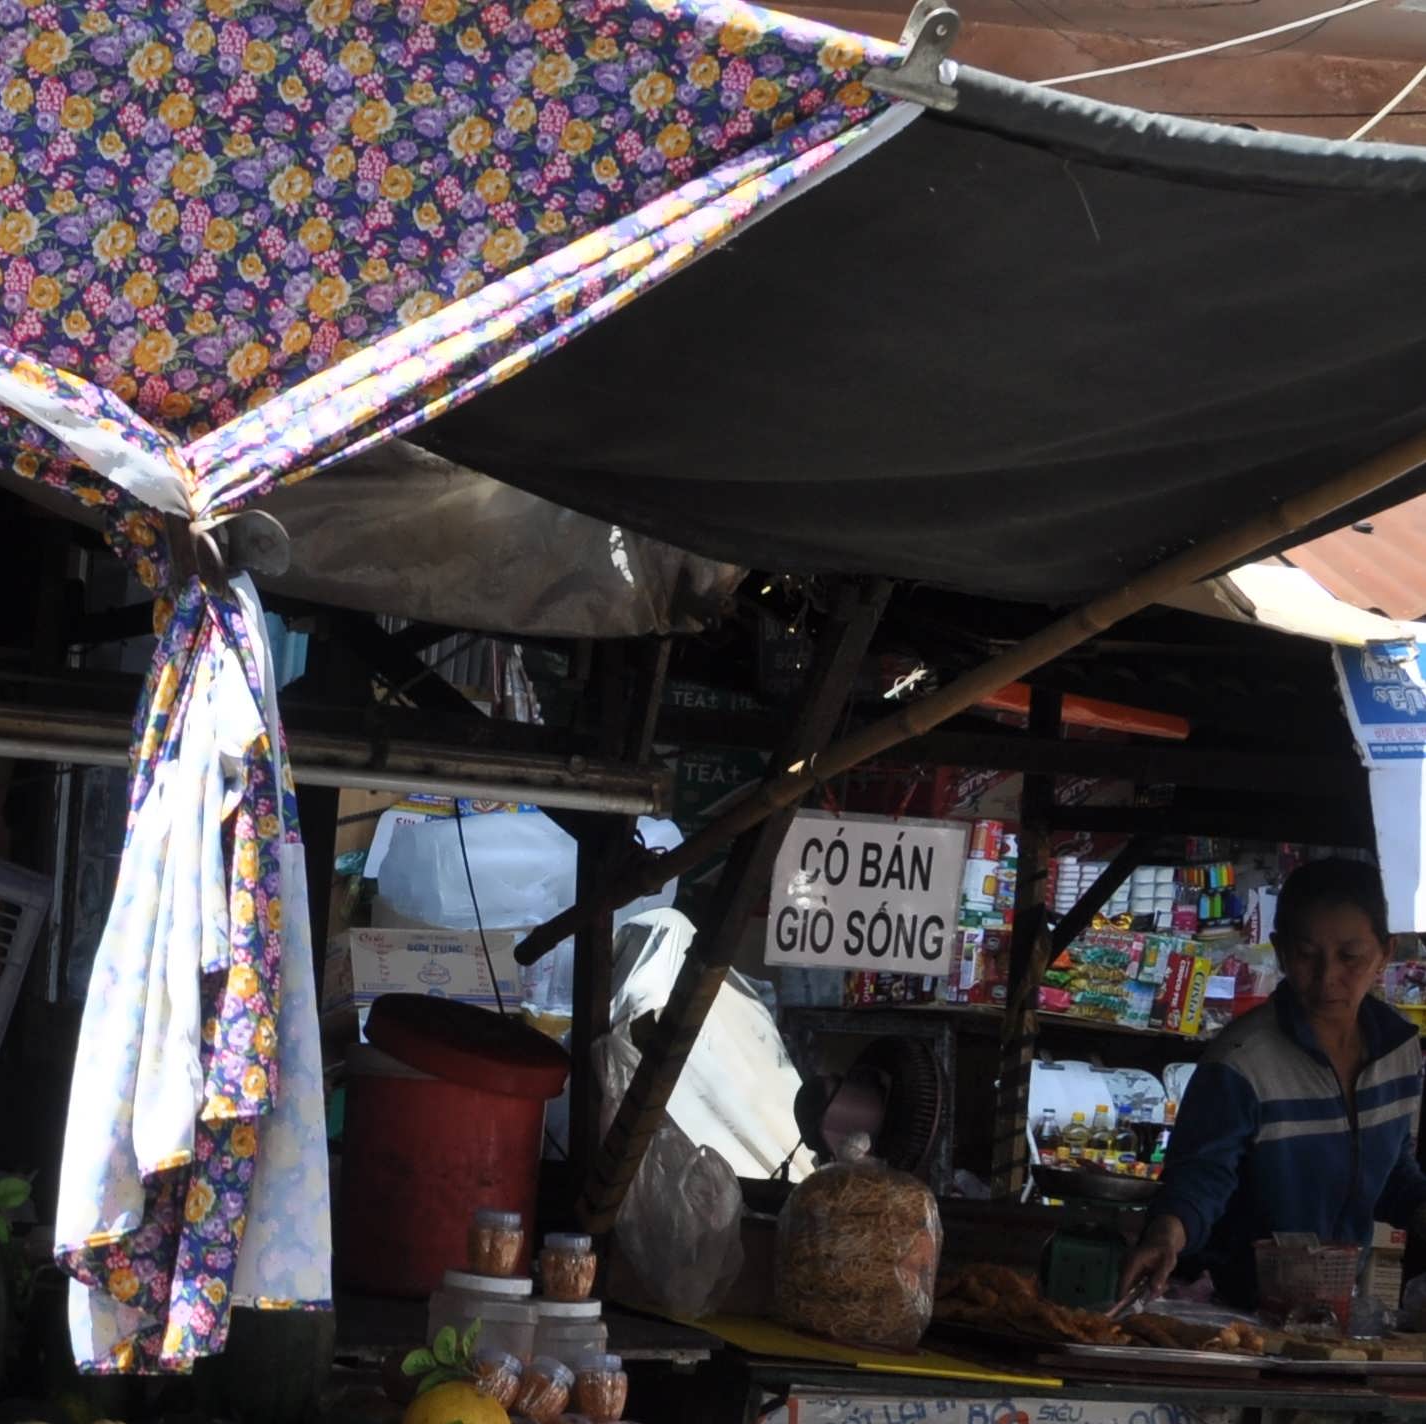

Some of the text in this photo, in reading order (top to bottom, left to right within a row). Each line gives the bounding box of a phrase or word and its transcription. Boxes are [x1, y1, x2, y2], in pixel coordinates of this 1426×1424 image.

[800, 827, 934, 892] CÓ BÁN
[776, 895, 945, 961] GIÒ SỐNG
